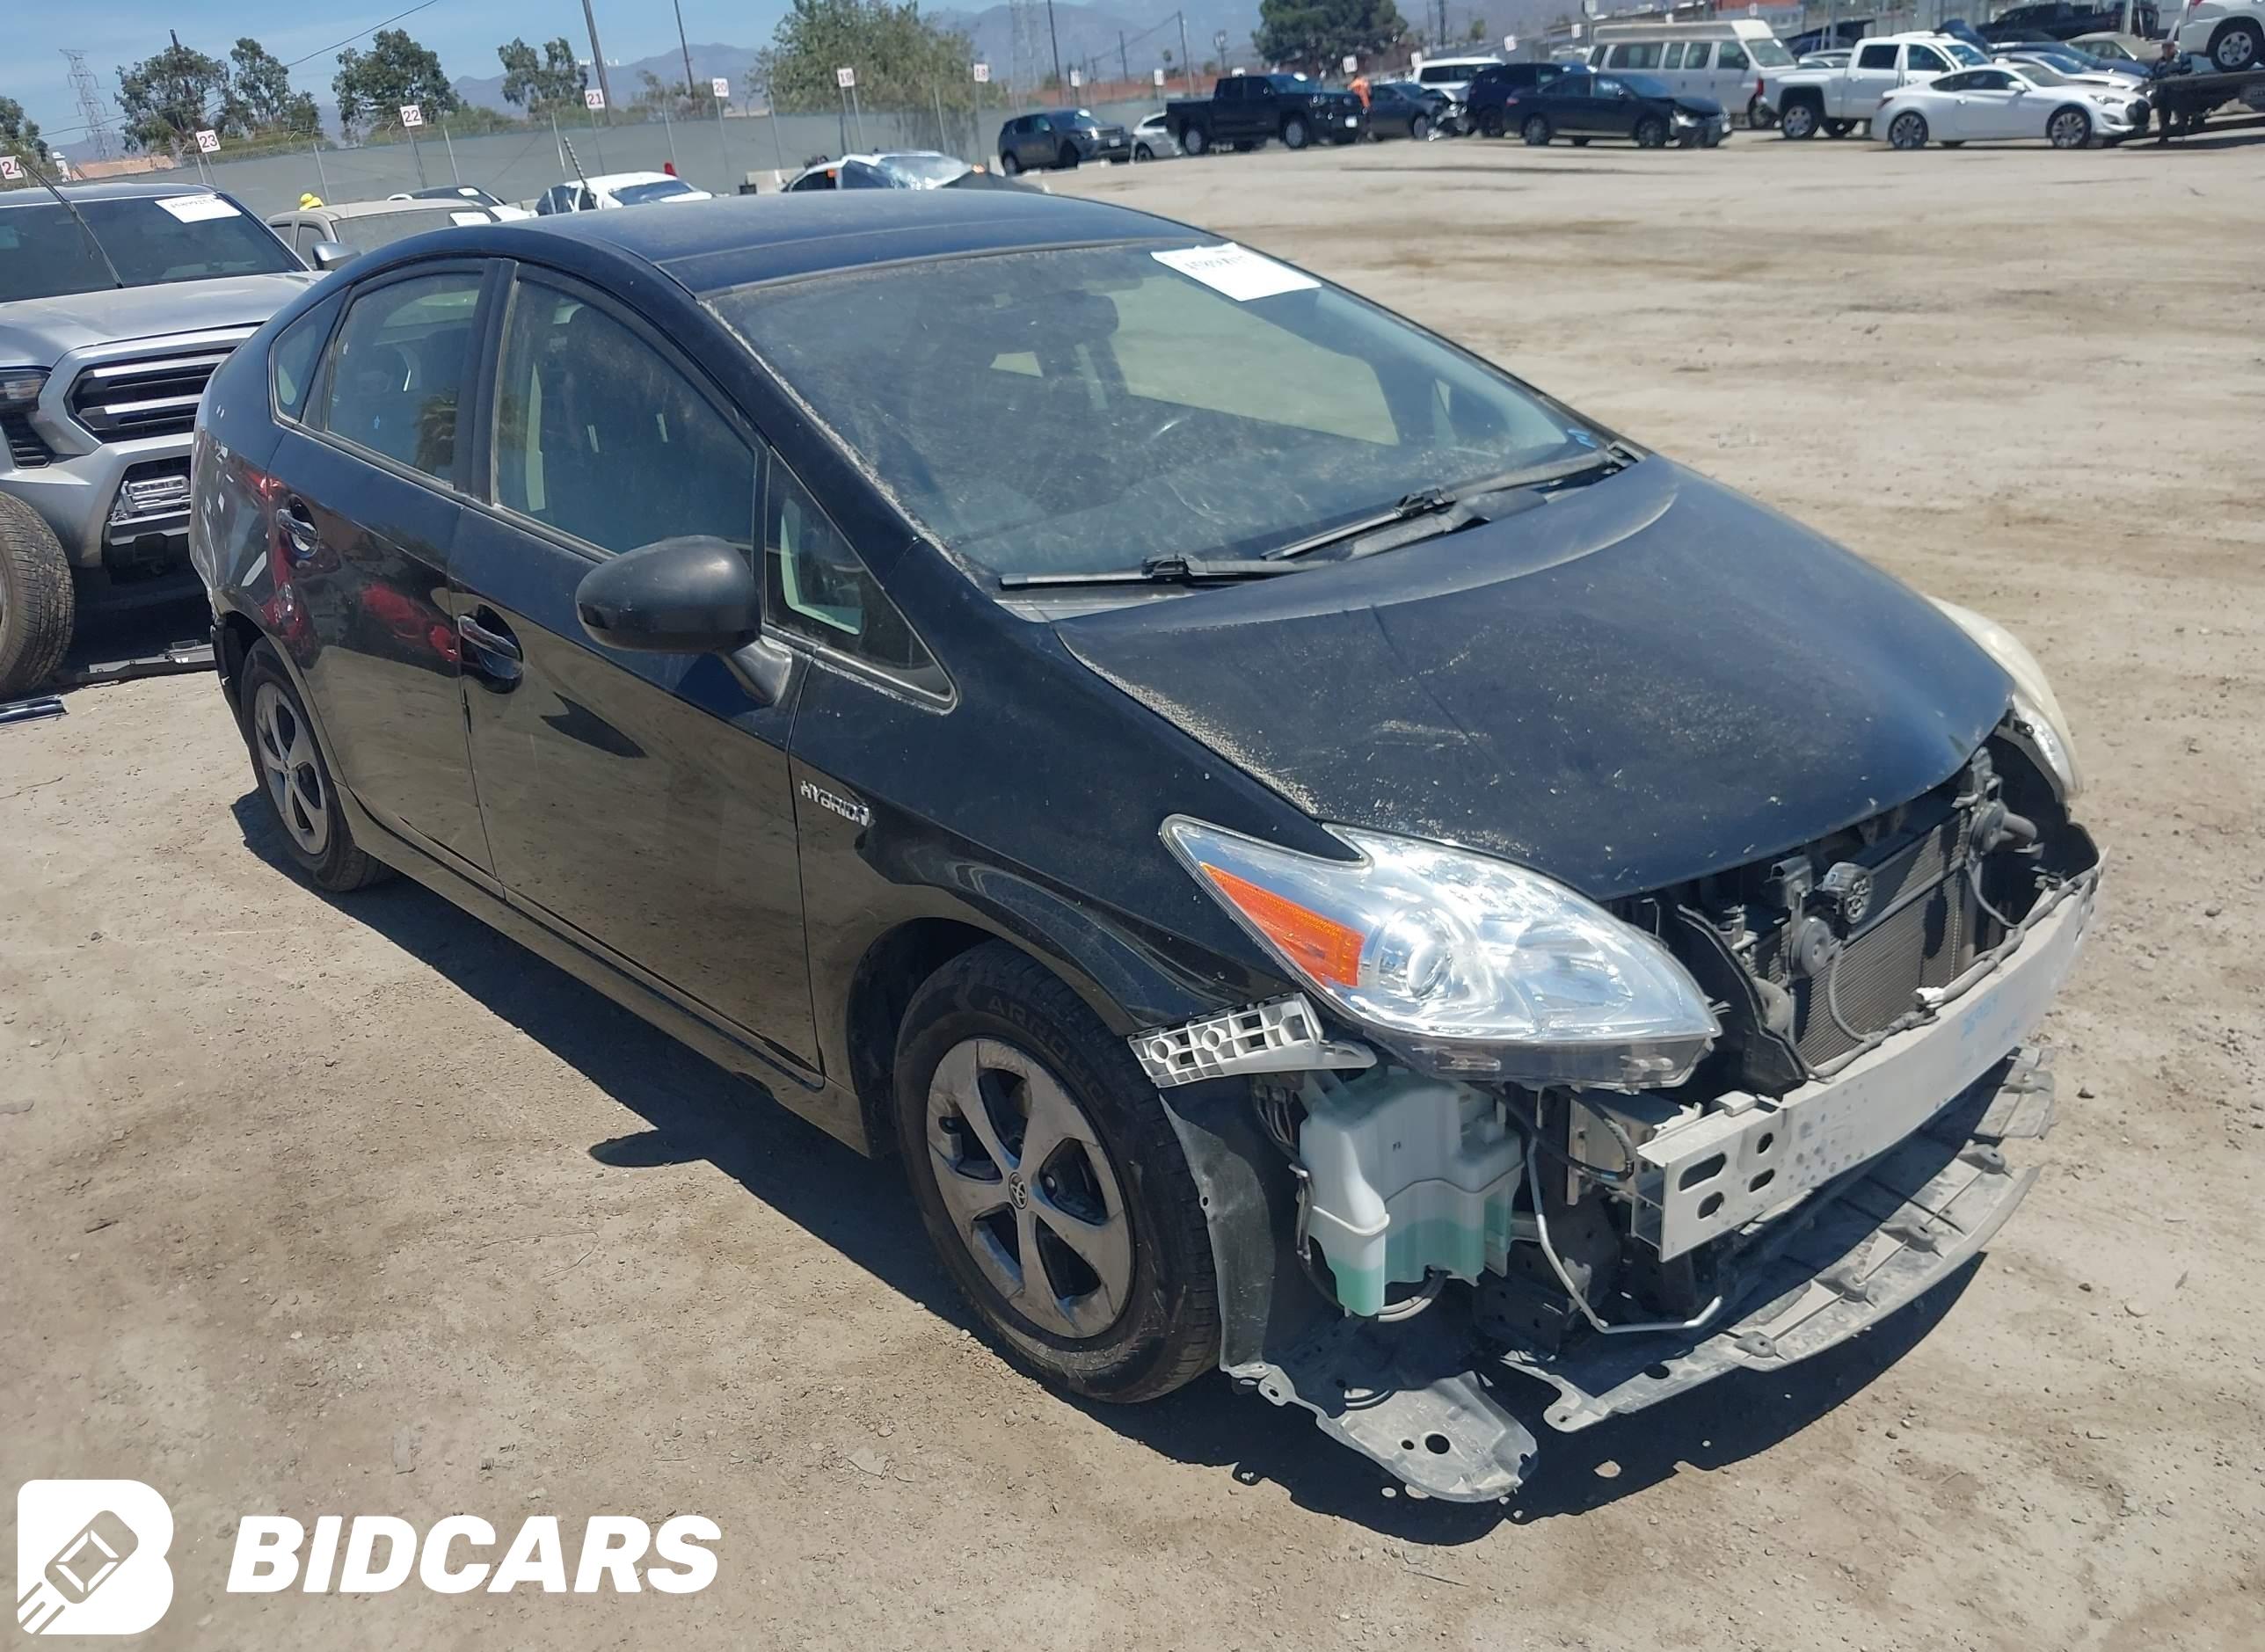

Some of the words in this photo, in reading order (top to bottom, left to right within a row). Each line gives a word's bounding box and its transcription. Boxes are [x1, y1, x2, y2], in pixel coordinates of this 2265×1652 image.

[586, 93, 602, 105] 21
[404, 109, 420, 122] 22
[199, 135, 217, 148] 23
[800, 781, 859, 823] HYBRID
